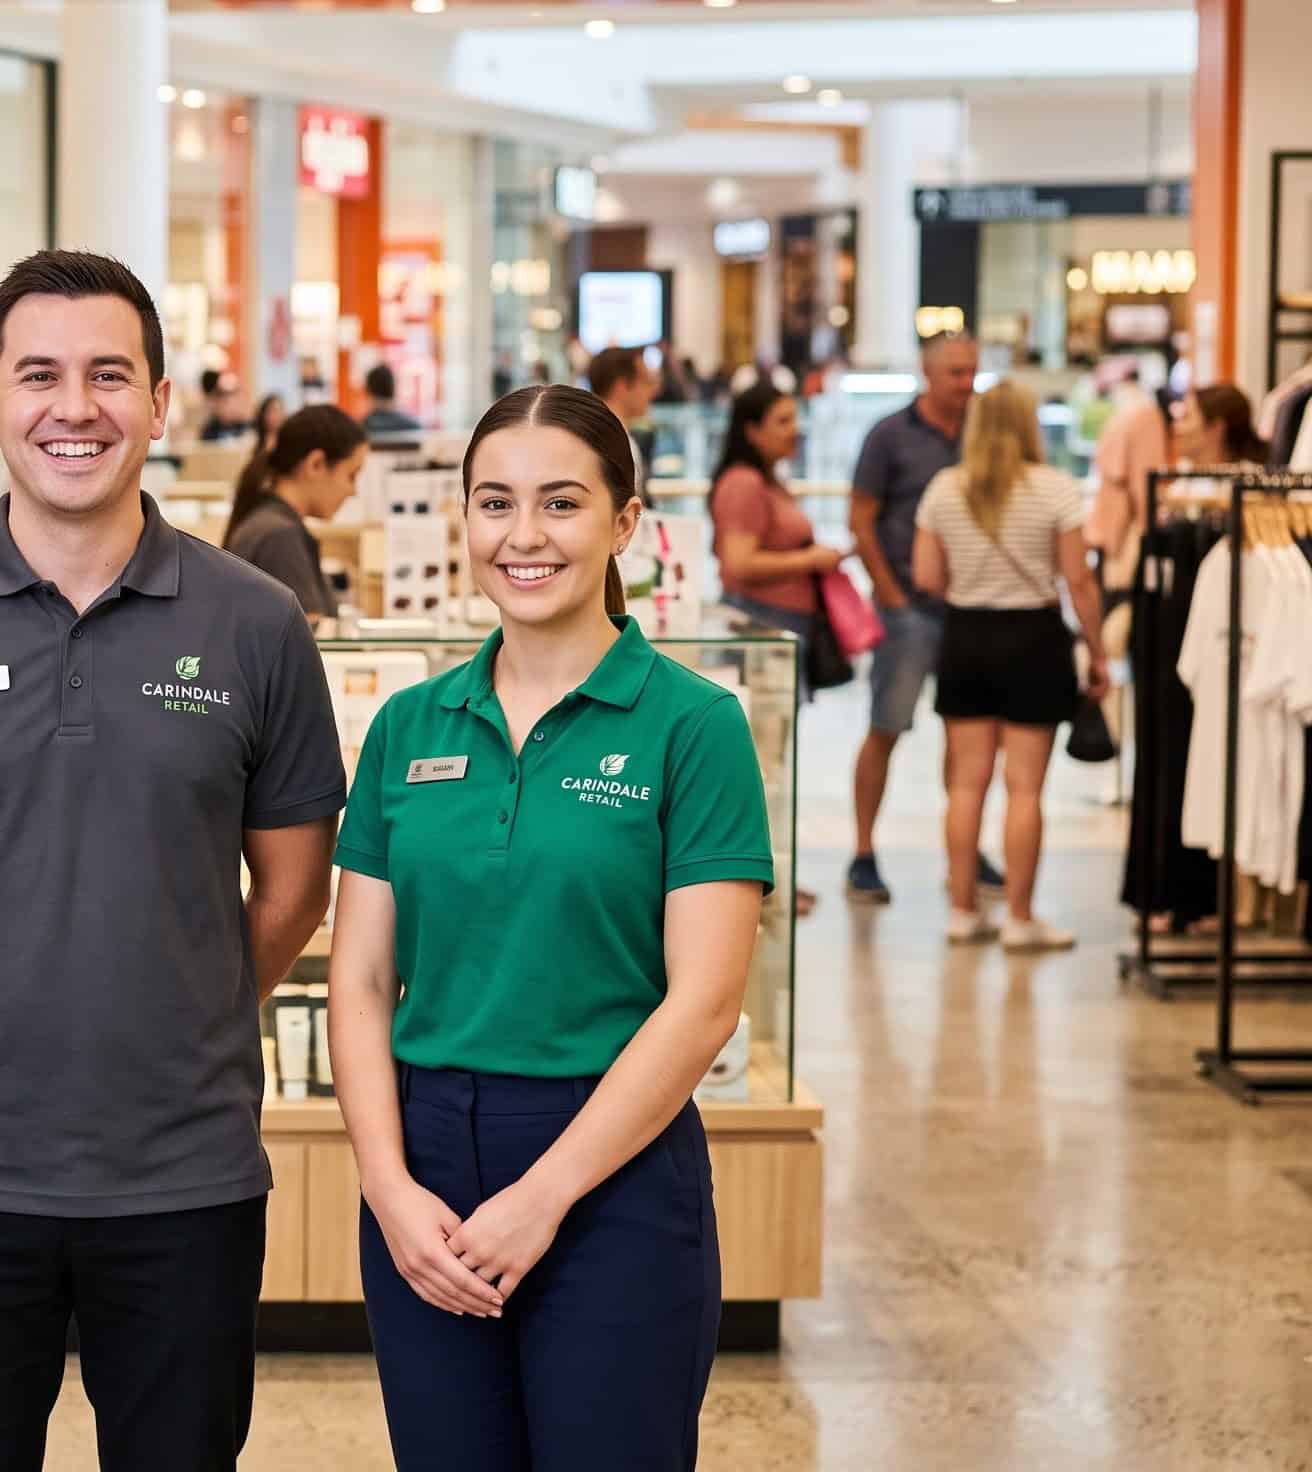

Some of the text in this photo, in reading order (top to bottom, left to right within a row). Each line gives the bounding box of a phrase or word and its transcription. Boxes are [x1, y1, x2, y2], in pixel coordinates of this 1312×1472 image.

[141, 682, 231, 705] CARINDALE
[164, 700, 209, 714] RETAIL
[560, 777, 651, 800] CARINDALE
[578, 793, 624, 808] RETAIL
